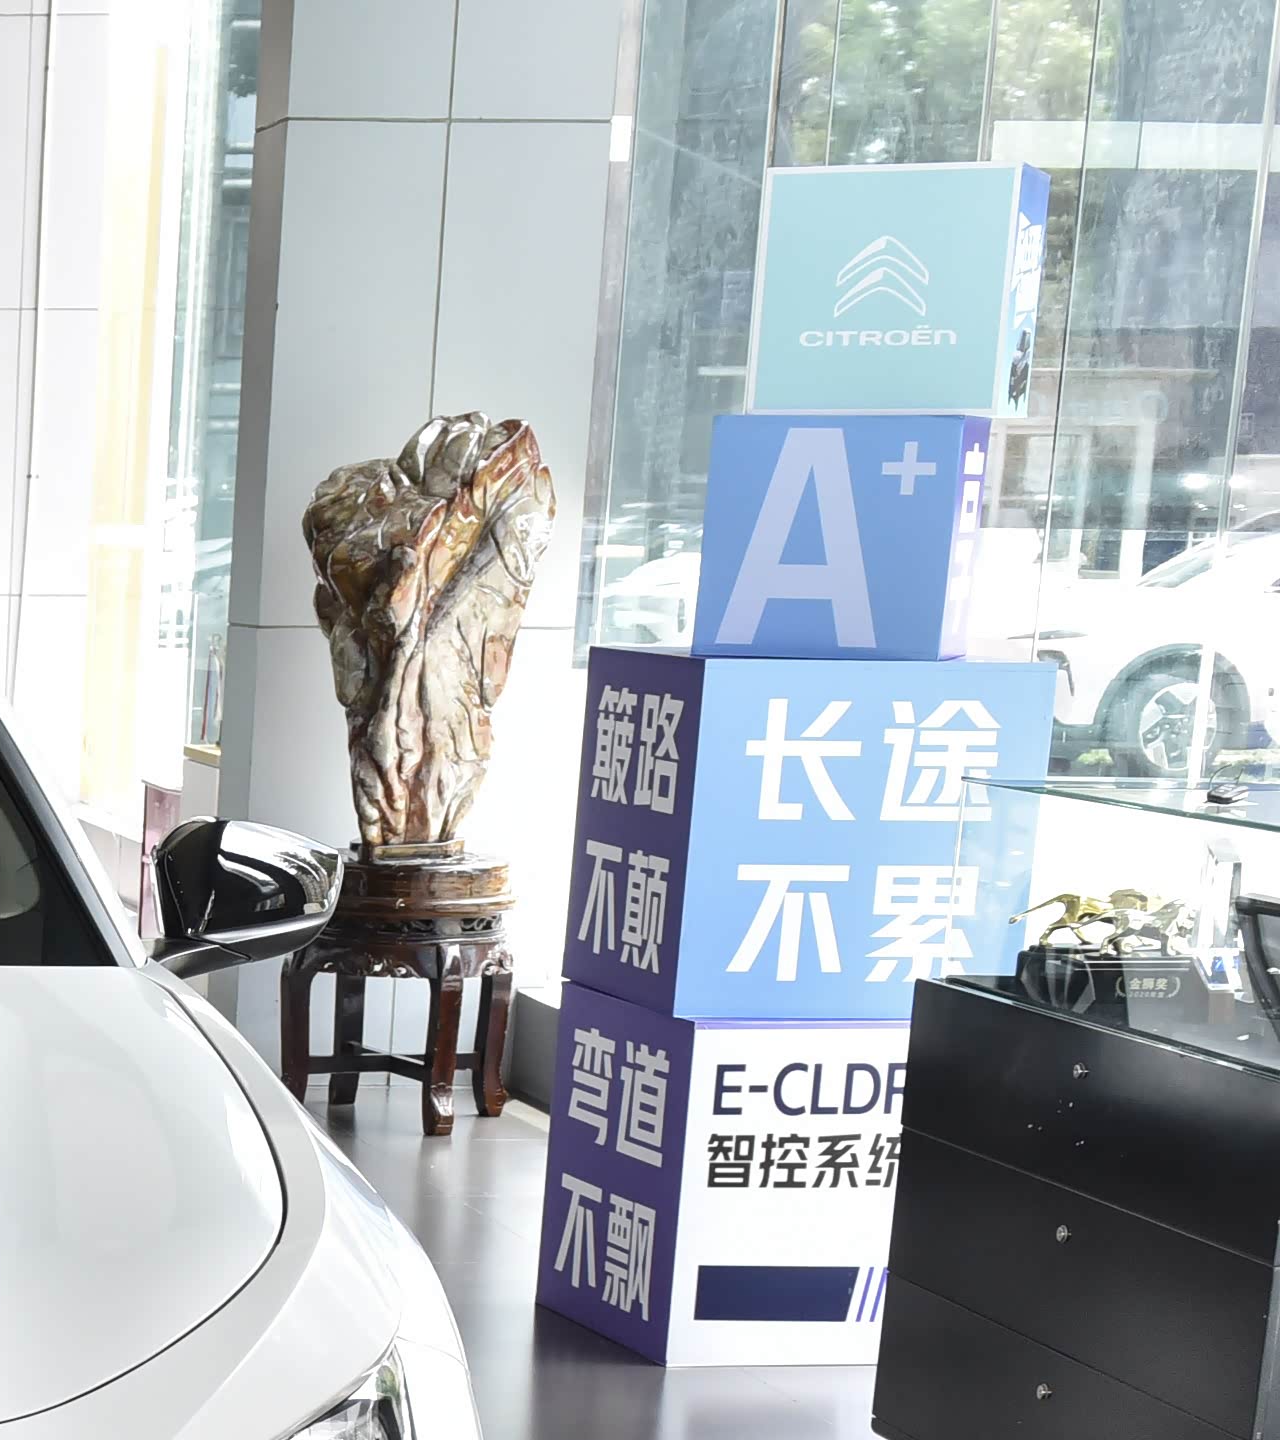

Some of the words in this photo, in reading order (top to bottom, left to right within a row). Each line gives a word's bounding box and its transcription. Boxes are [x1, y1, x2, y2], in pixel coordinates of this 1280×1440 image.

[745, 698, 1003, 821] 长途
[576, 838, 671, 975] 不颠
[725, 863, 980, 983] 不累
[567, 1027, 671, 1168] 弯道
[553, 1171, 657, 1322] 不飘
